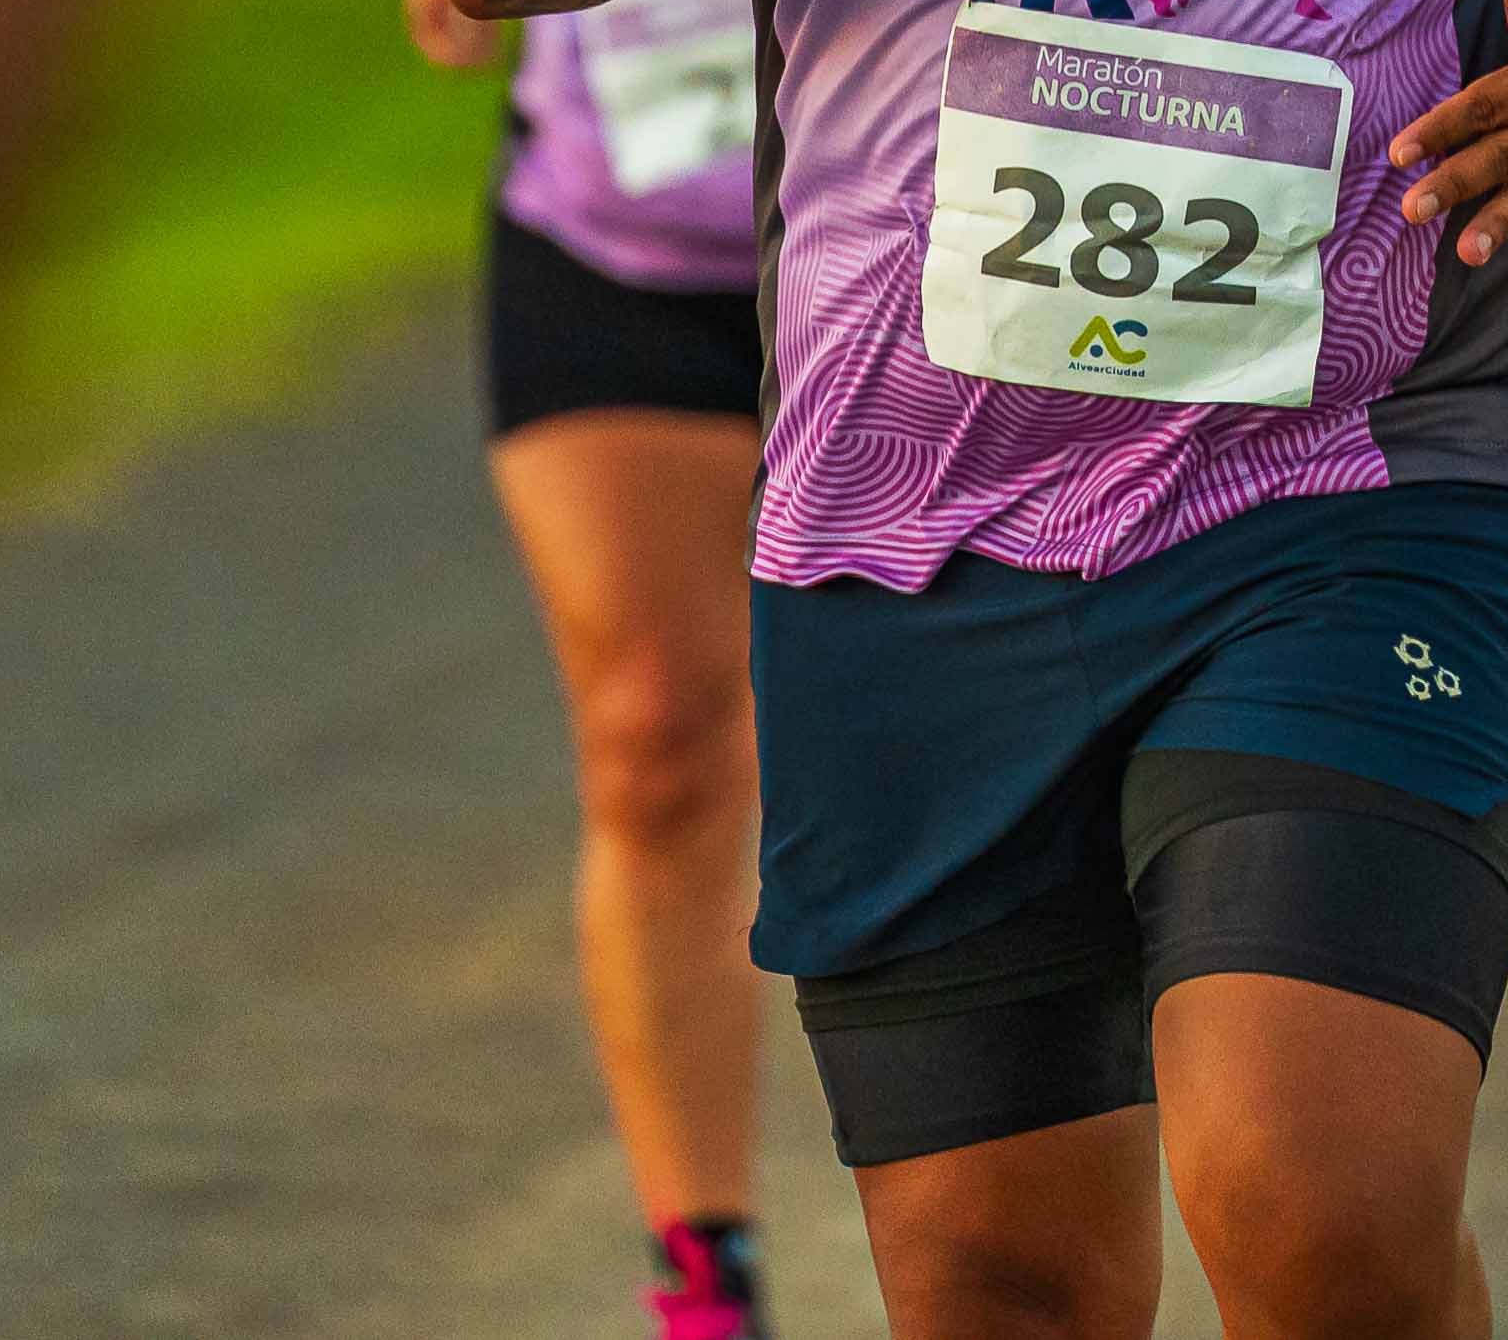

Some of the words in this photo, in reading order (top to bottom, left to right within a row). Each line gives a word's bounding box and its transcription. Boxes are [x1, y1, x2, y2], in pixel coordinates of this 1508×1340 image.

[1035, 45, 1163, 89] Maratón
[1030, 77, 1245, 136] NOCTURNA
[980, 166, 1261, 306] 282
[1068, 361, 1145, 378] AlvearCiudad
